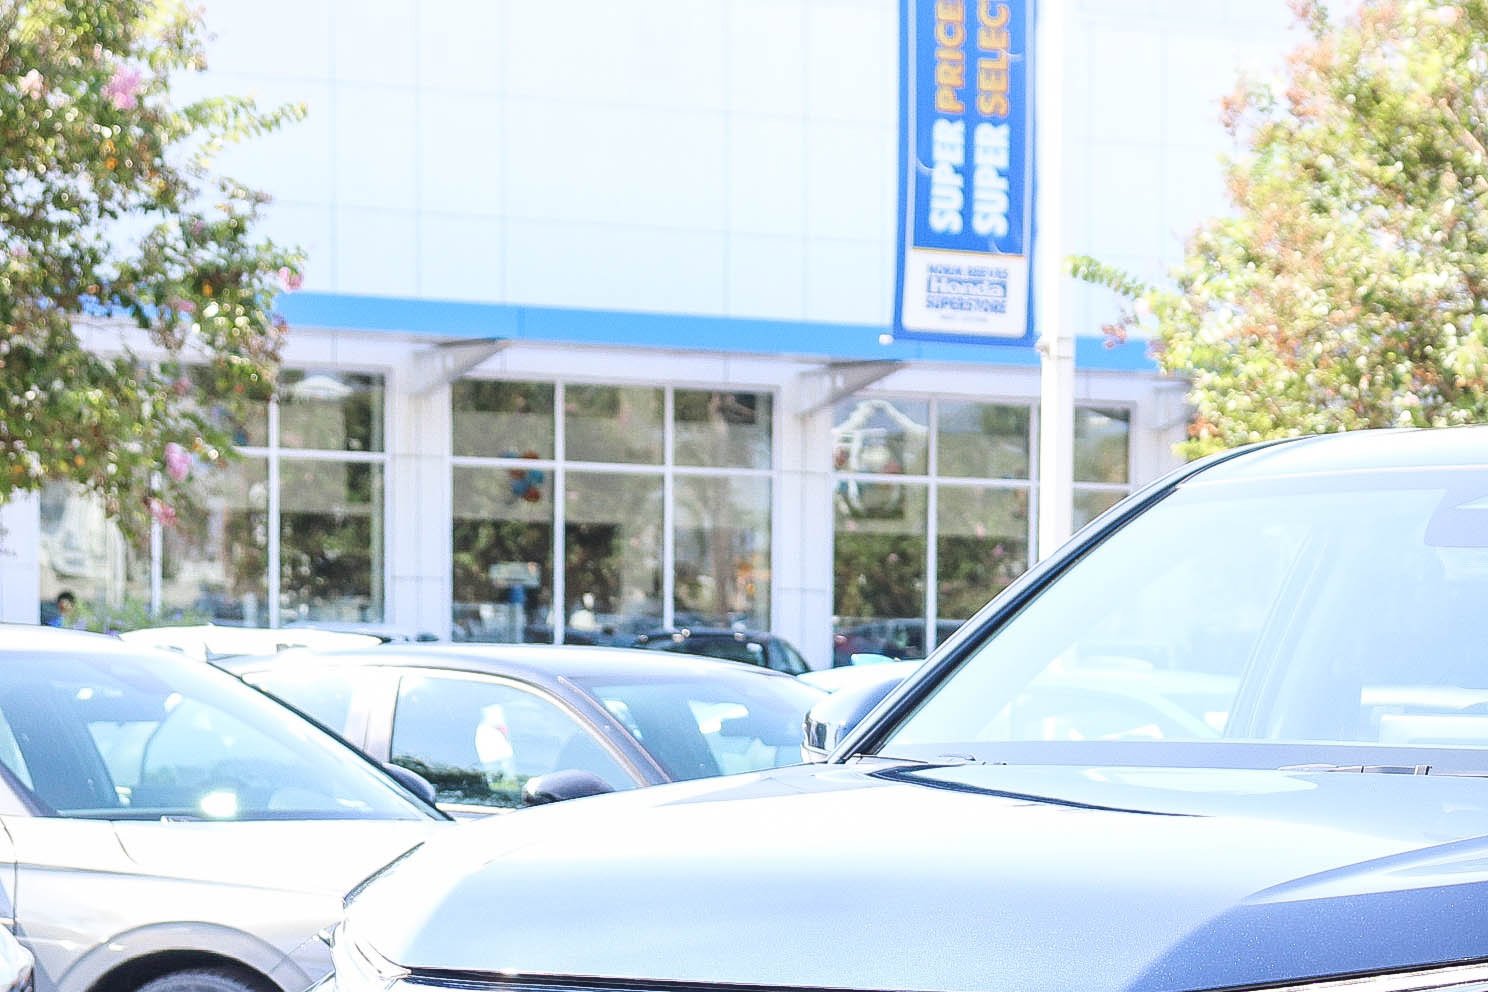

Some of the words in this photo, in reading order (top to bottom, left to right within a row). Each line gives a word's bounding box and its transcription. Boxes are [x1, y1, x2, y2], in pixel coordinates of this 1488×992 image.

[934, 0, 966, 114] PRICE
[976, 0, 1011, 117] SELEC
[929, 118, 966, 235] SUPER
[972, 122, 1011, 238] SUPER
